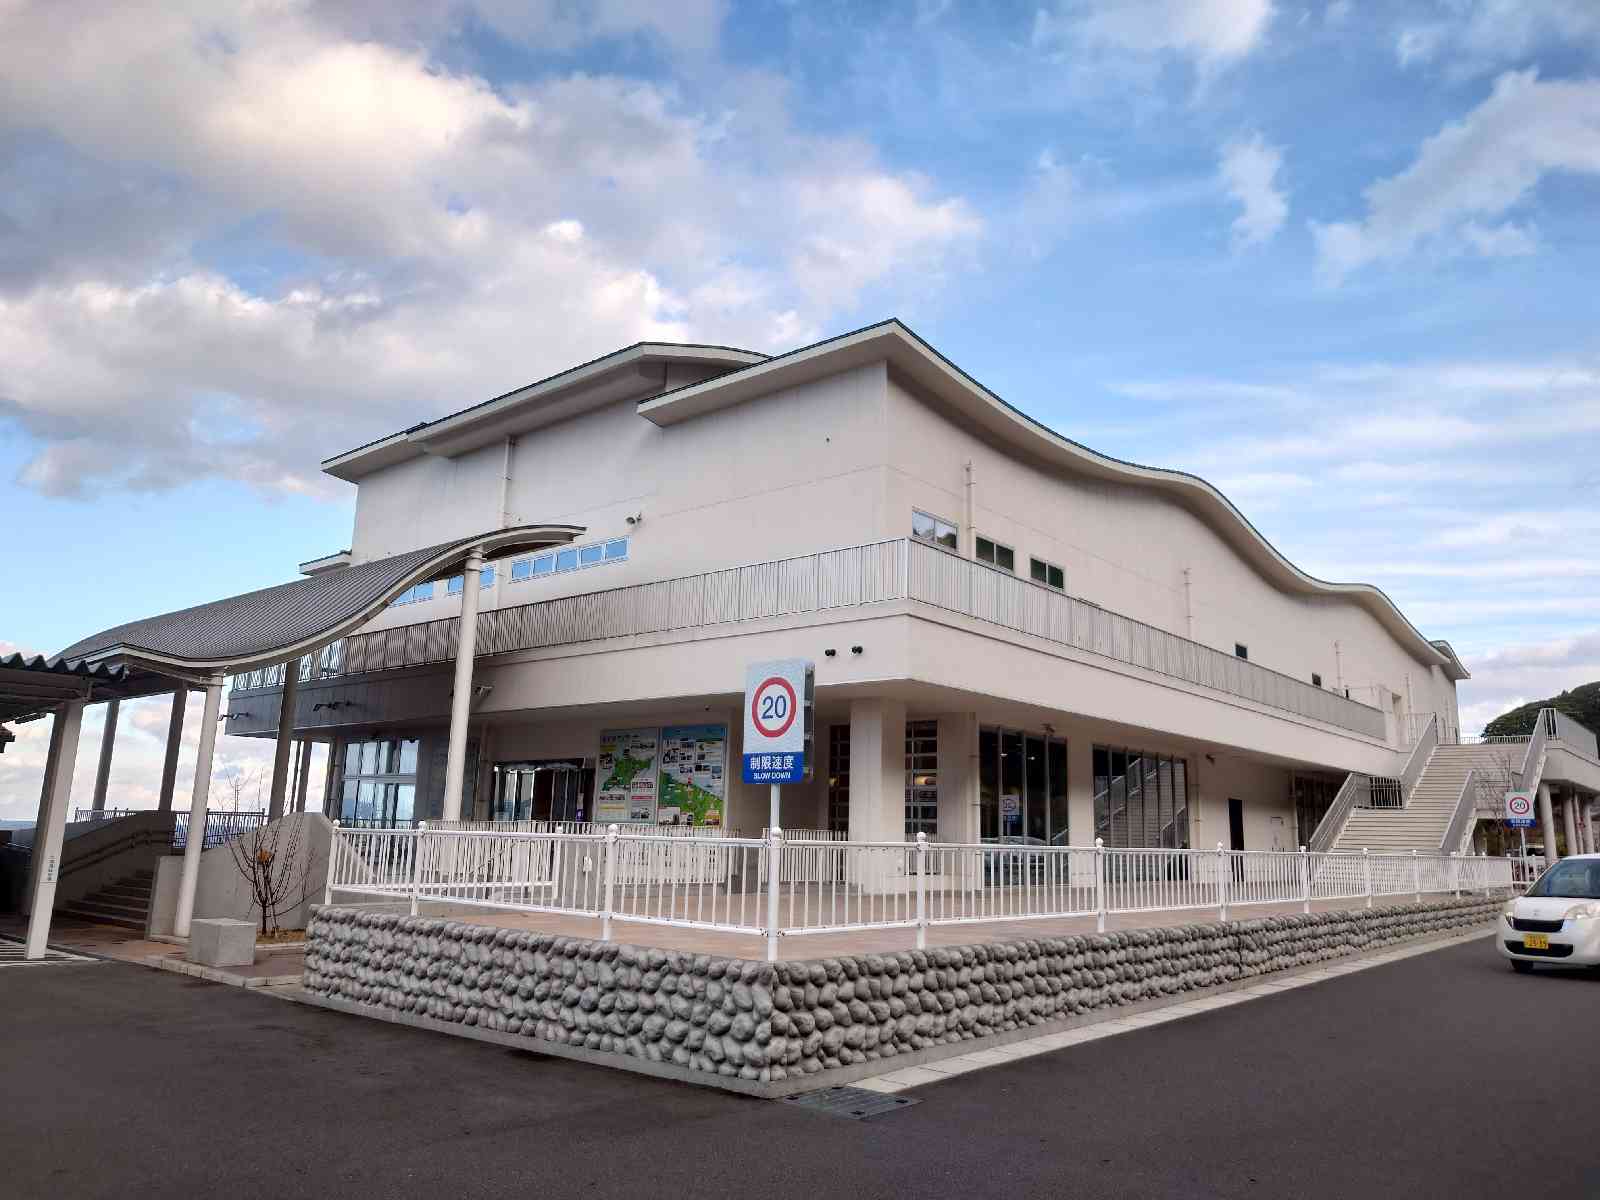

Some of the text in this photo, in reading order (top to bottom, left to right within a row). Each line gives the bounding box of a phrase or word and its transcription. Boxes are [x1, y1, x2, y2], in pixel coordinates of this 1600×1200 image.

[761, 695, 787, 719] 20
[750, 756, 794, 770] 制限速度
[753, 772, 791, 780] SLOW DOWN
[1514, 801, 1526, 810] 20
